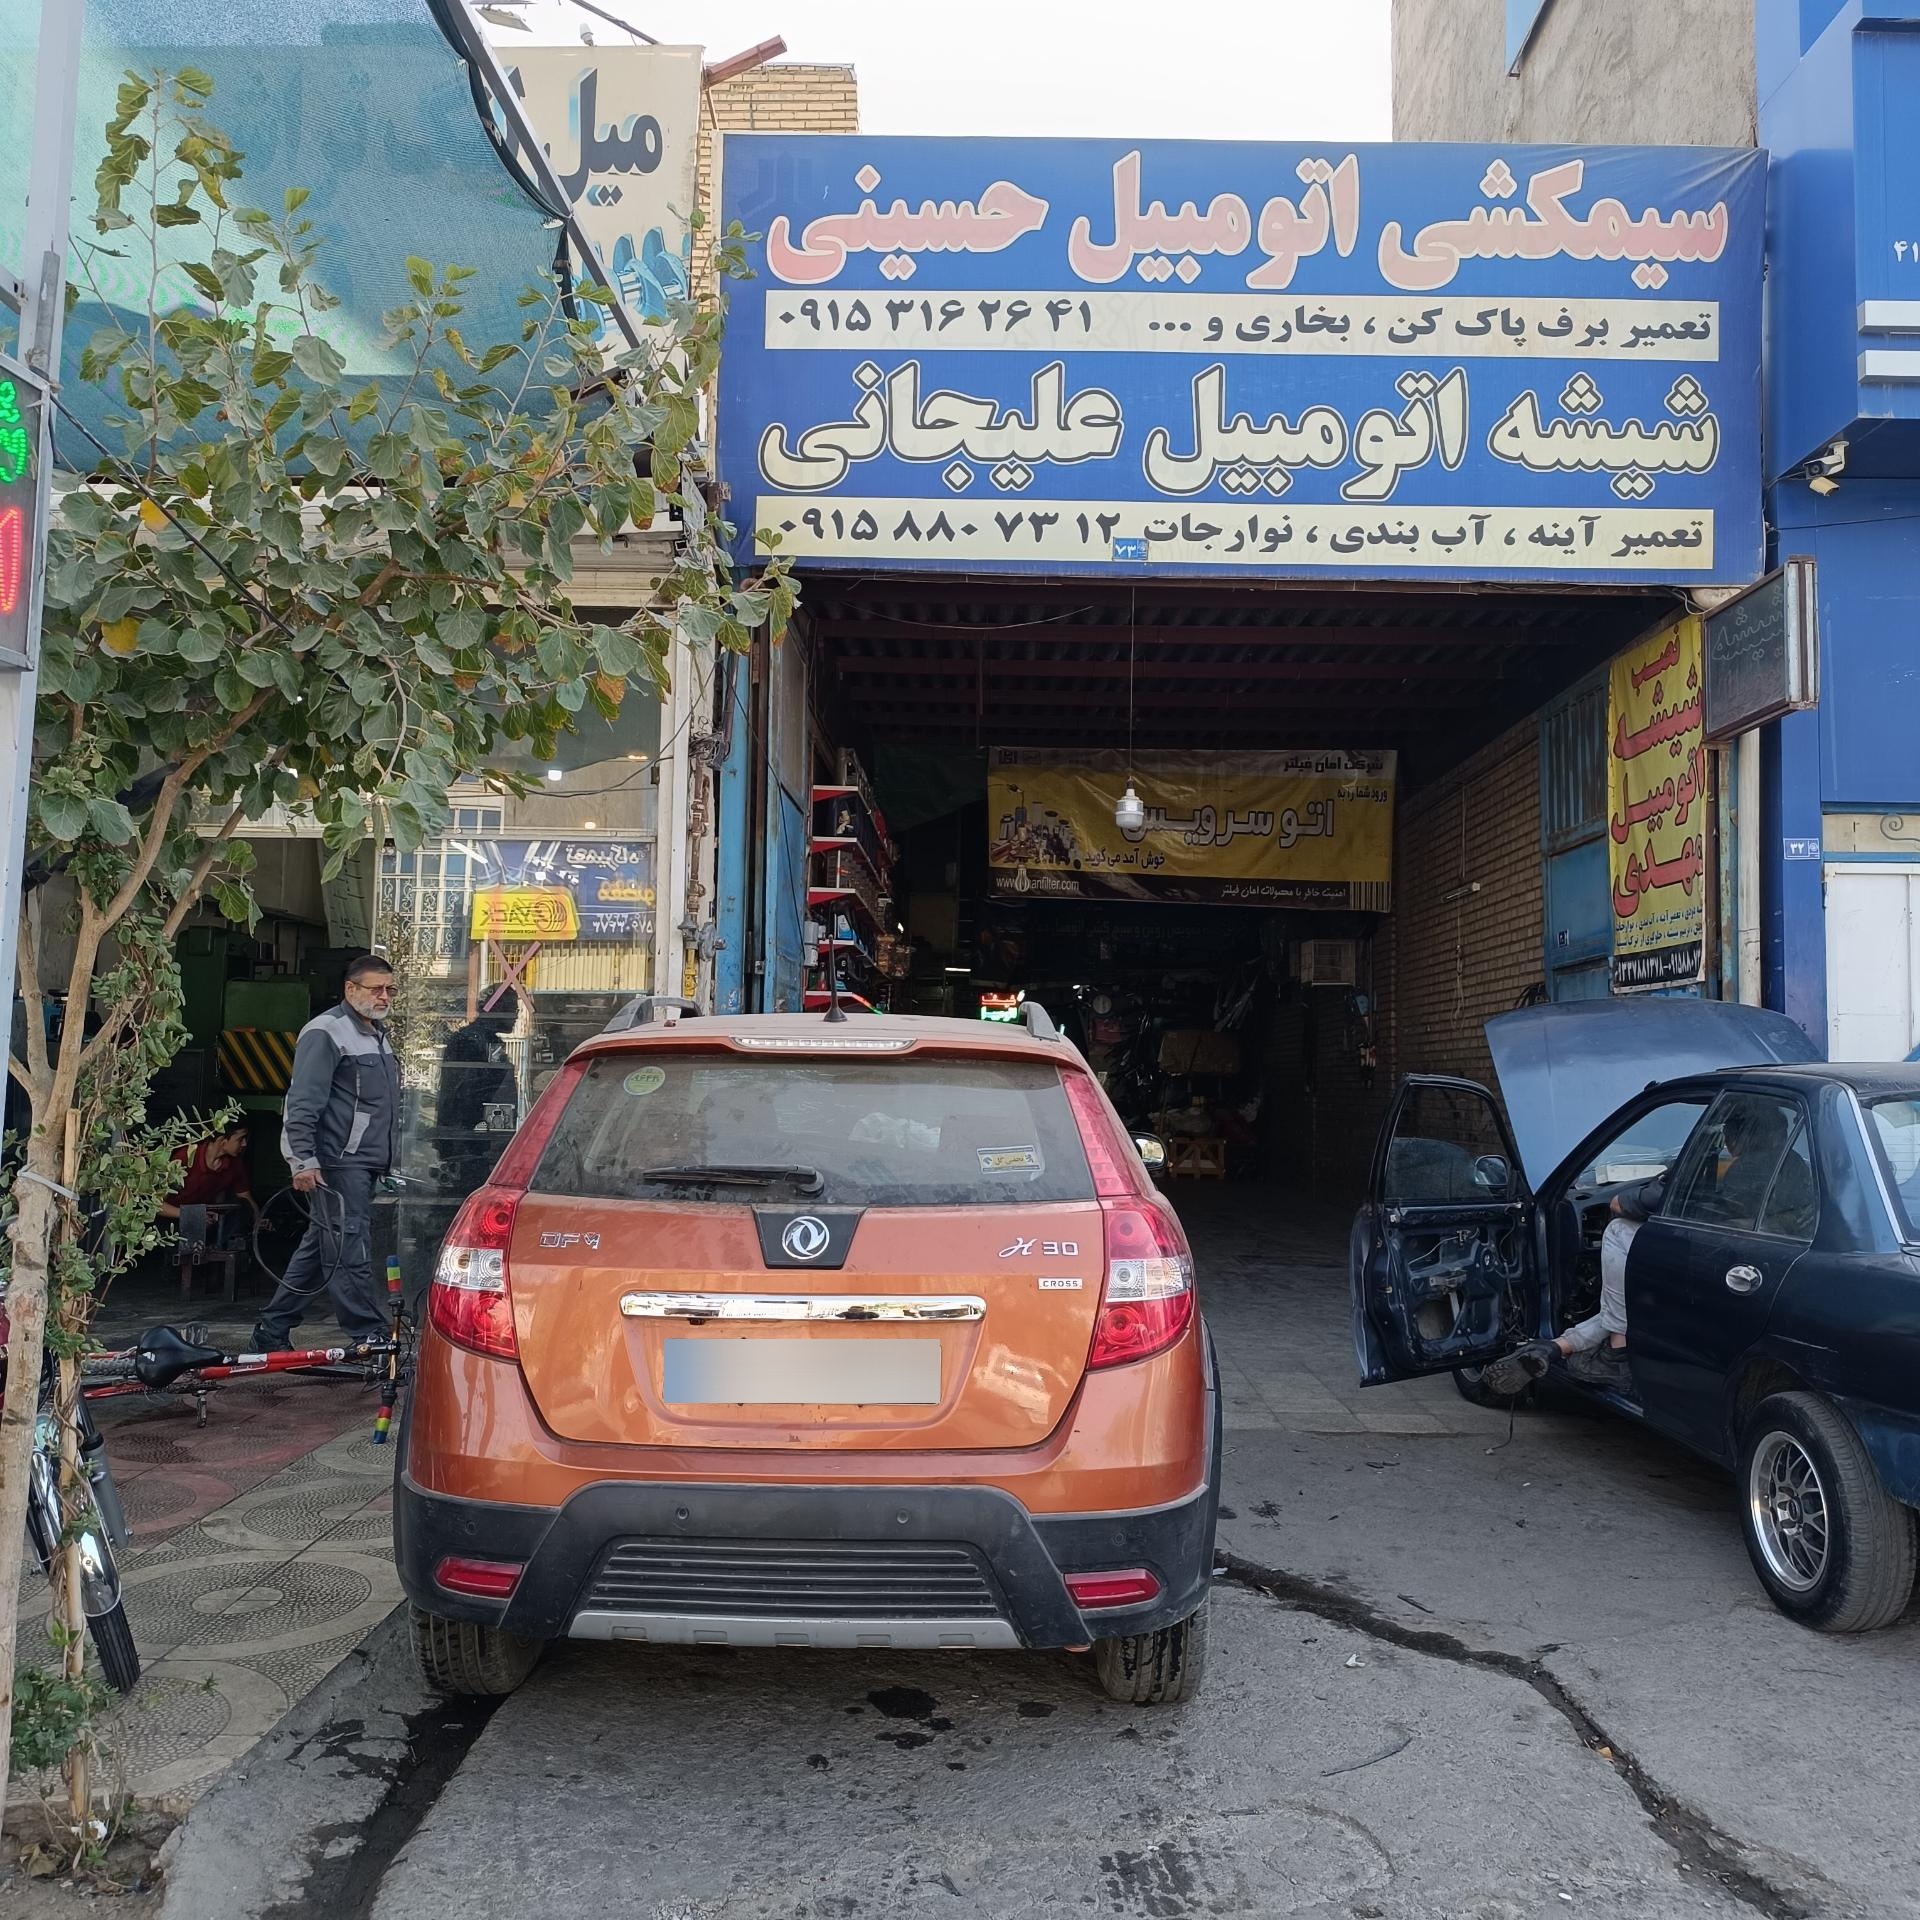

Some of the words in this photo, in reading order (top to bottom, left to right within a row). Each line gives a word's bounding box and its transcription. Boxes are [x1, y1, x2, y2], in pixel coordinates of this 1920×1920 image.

[766, 164, 1049, 284] حسینی
[1068, 151, 1361, 290] اتومبیل
[1377, 158, 1730, 291] سیمکشی
[778, 299, 872, 333] ۰۹۱۵
[885, 299, 966, 333] ۳۱۶
[977, 299, 1032, 333] ۲۶
[1045, 299, 1092, 334] ۴۱
[1208, 316, 1224, 341] و
[1235, 304, 1351, 348] بخاری
[1454, 307, 1526, 348] پاک
[1537, 307, 1610, 348] برف
[1620, 312, 1712, 349] تعمیر
[758, 360, 1124, 493] علیجانی
[1143, 363, 1469, 502] اتومبیل
[1488, 371, 1719, 501] شیشه
[779, 507, 879, 543] ۰۹۱۵
[892, 510, 979, 543] ۸۸۰
[994, 511, 1059, 543] ۷۳
[1431, 515, 1491, 551] آب
[1610, 522, 1705, 557] تعمیر
[1630, 626, 1681, 697] نصب
[1612, 665, 1702, 762] شیشه
[1283, 755, 1313, 773] فیلتر
[1315, 757, 1342, 773] امان
[1343, 757, 1384, 774] شرکت
[1611, 747, 1706, 845] اتومبیل
[1120, 804, 1275, 847] سرویس
[1279, 799, 1334, 848] اتو
[1122, 848, 1140, 864] آمد
[1142, 850, 1166, 869] خوش
[1221, 884, 1240, 898] فیلتر
[1241, 885, 1259, 898] امان
[1042, 1280, 1079, 1288] CROSS
